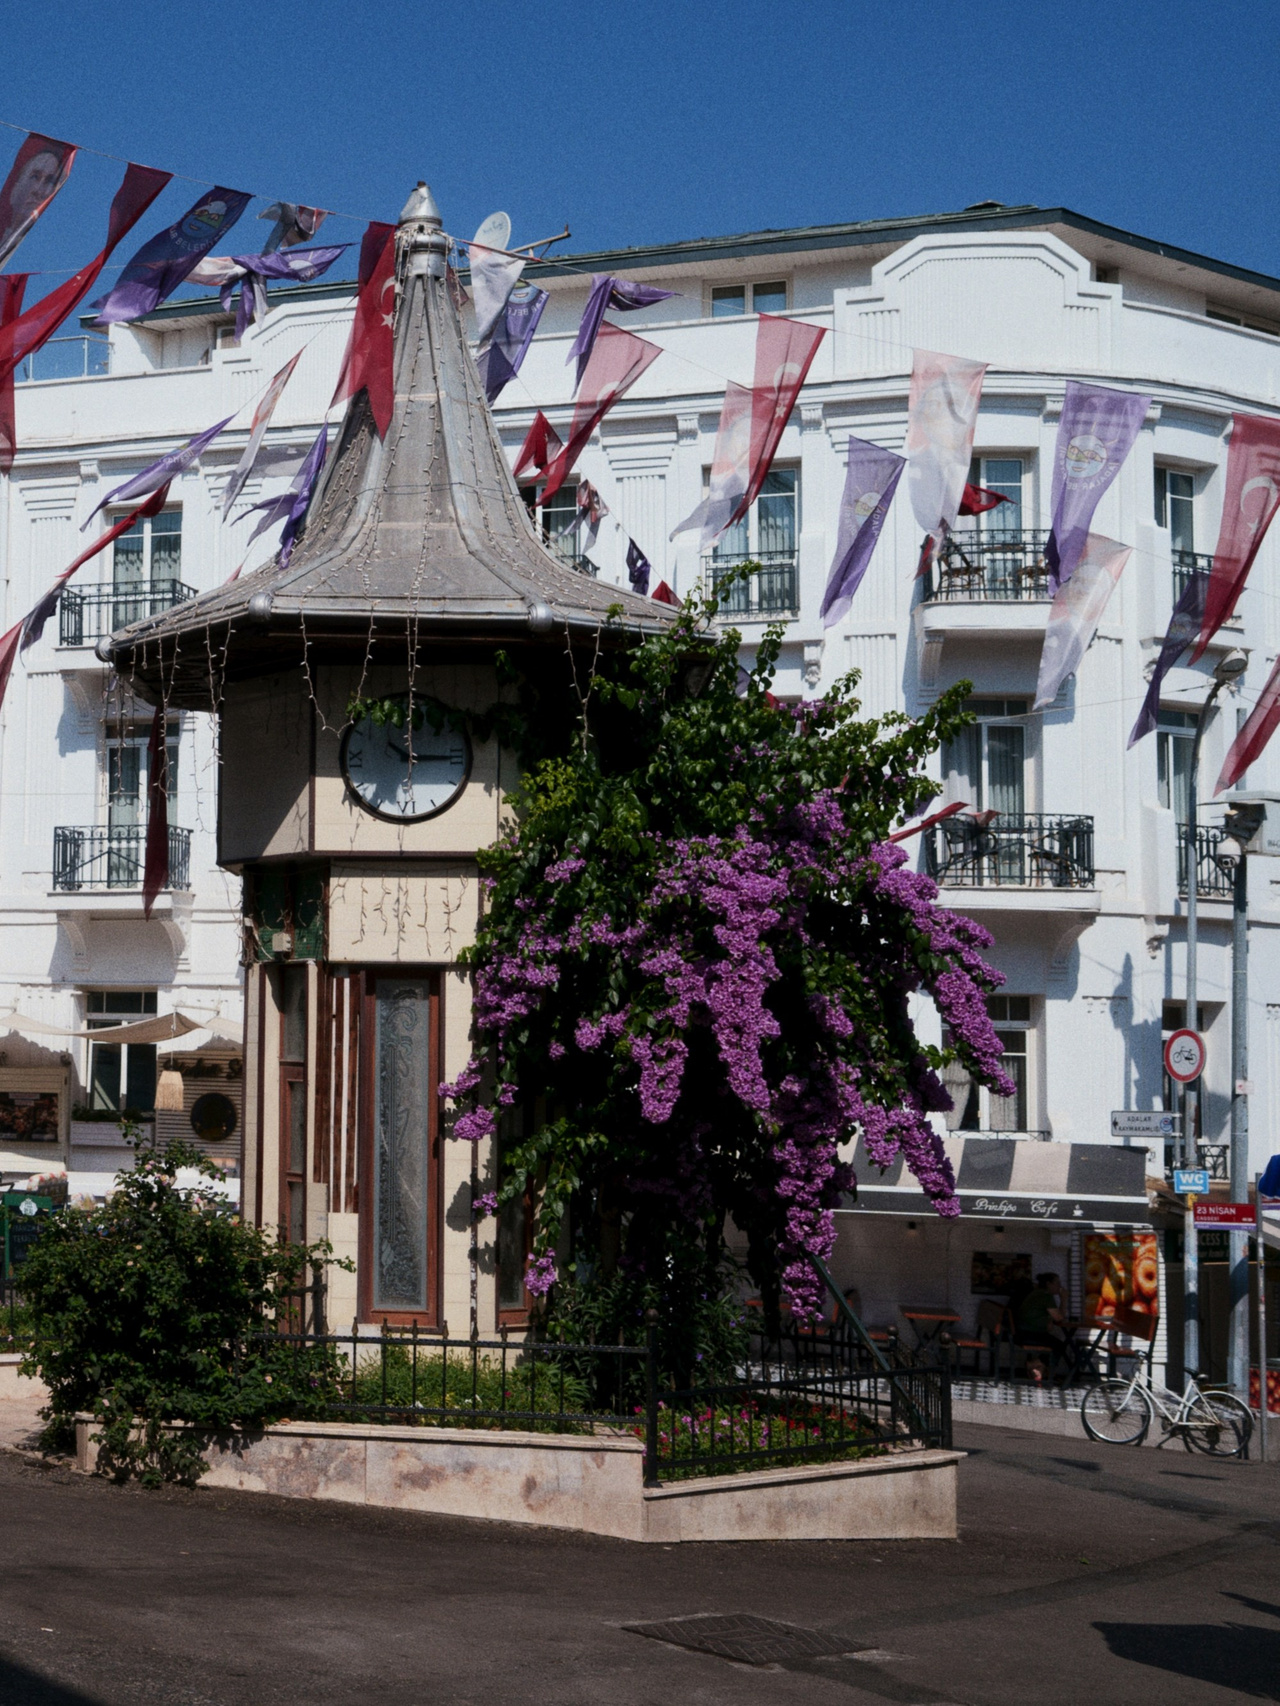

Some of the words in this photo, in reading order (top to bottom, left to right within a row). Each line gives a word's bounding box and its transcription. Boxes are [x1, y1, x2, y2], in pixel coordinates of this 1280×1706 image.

[397, 800, 417, 814] VI
[1179, 1174, 1204, 1184] WC
[972, 1197, 1017, 1216] Prinkipo
[1030, 1199, 1058, 1218] Cafe
[1196, 1206, 1207, 1215] 23
[1209, 1205, 1237, 1215] NİSAN
